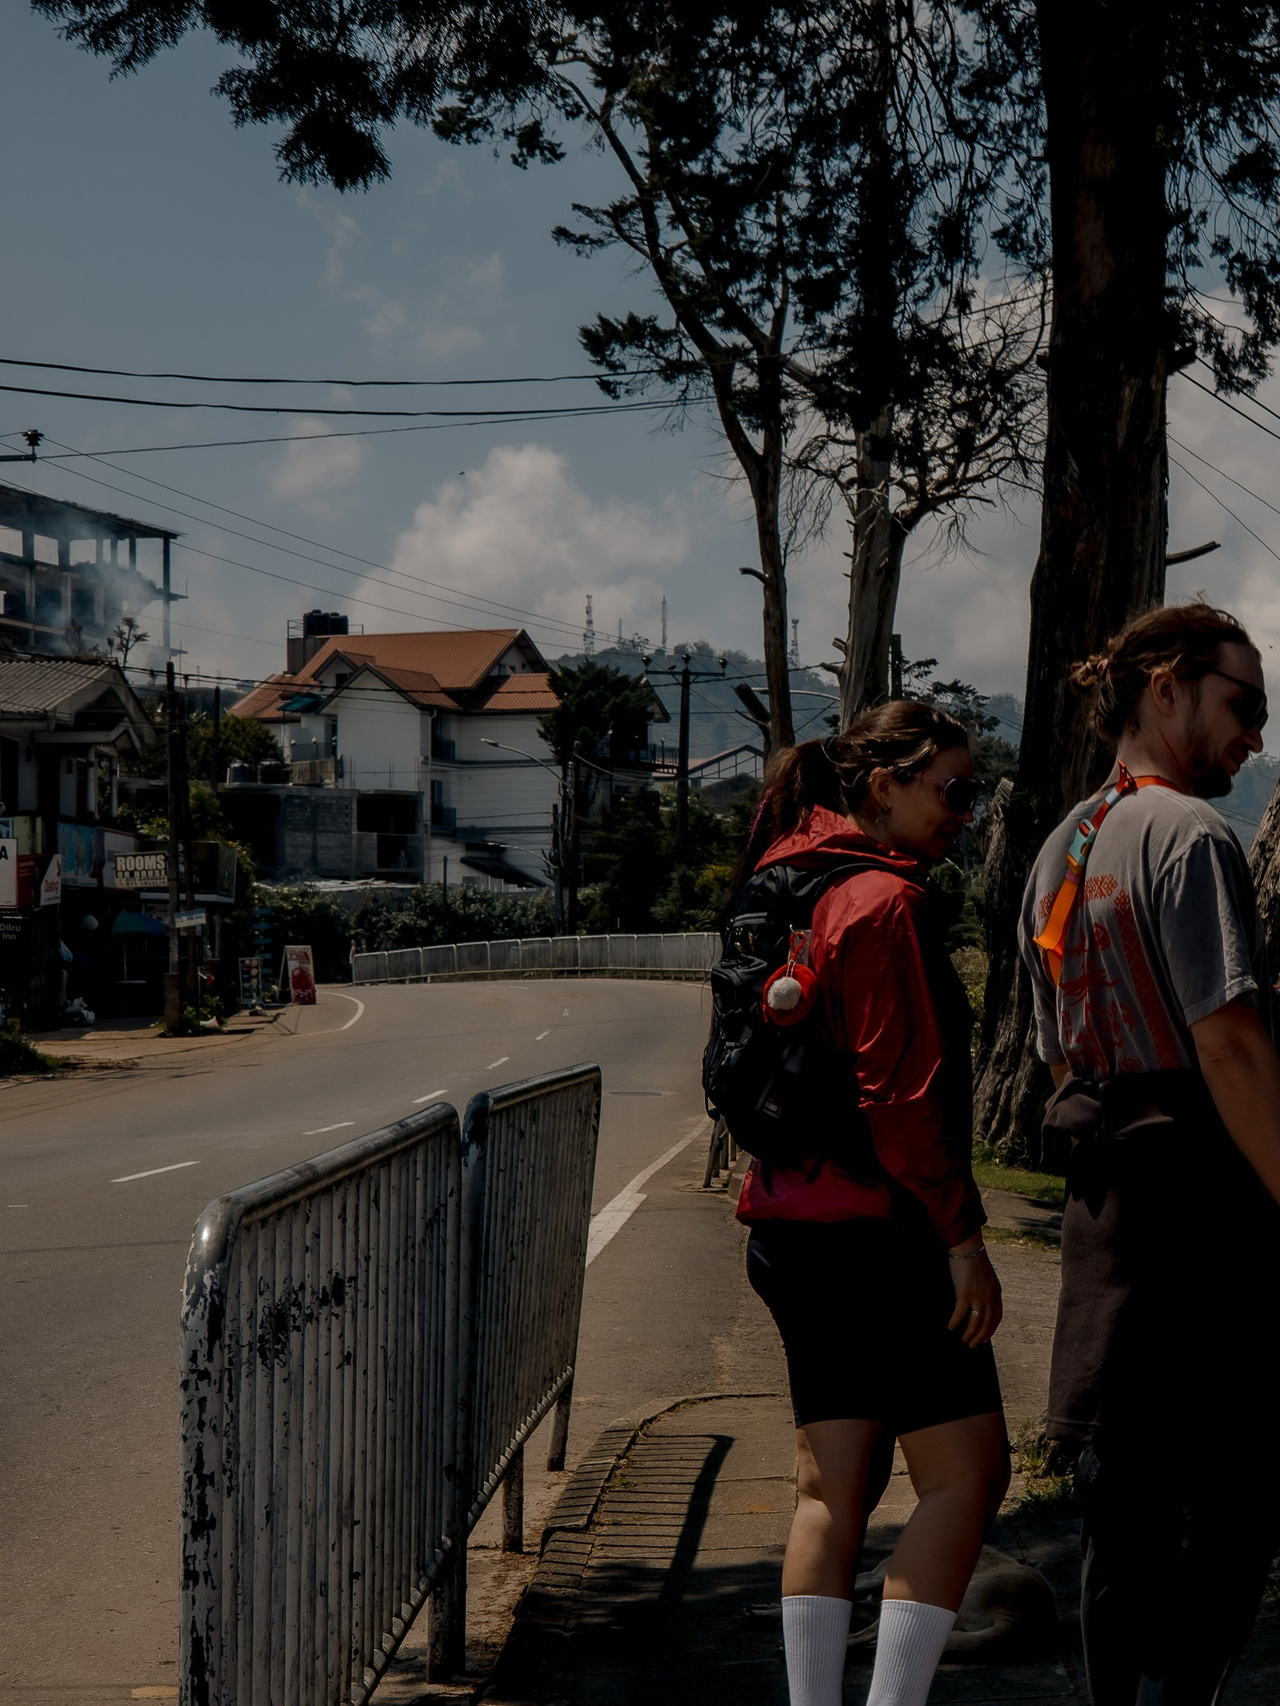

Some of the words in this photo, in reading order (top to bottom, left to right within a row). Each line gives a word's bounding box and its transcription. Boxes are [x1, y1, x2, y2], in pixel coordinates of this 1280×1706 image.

[116, 854, 166, 872] ROOMS
[134, 869, 166, 878] HOUSE
[44, 880, 59, 894] Dialog
[2, 933, 17, 941] Inn
